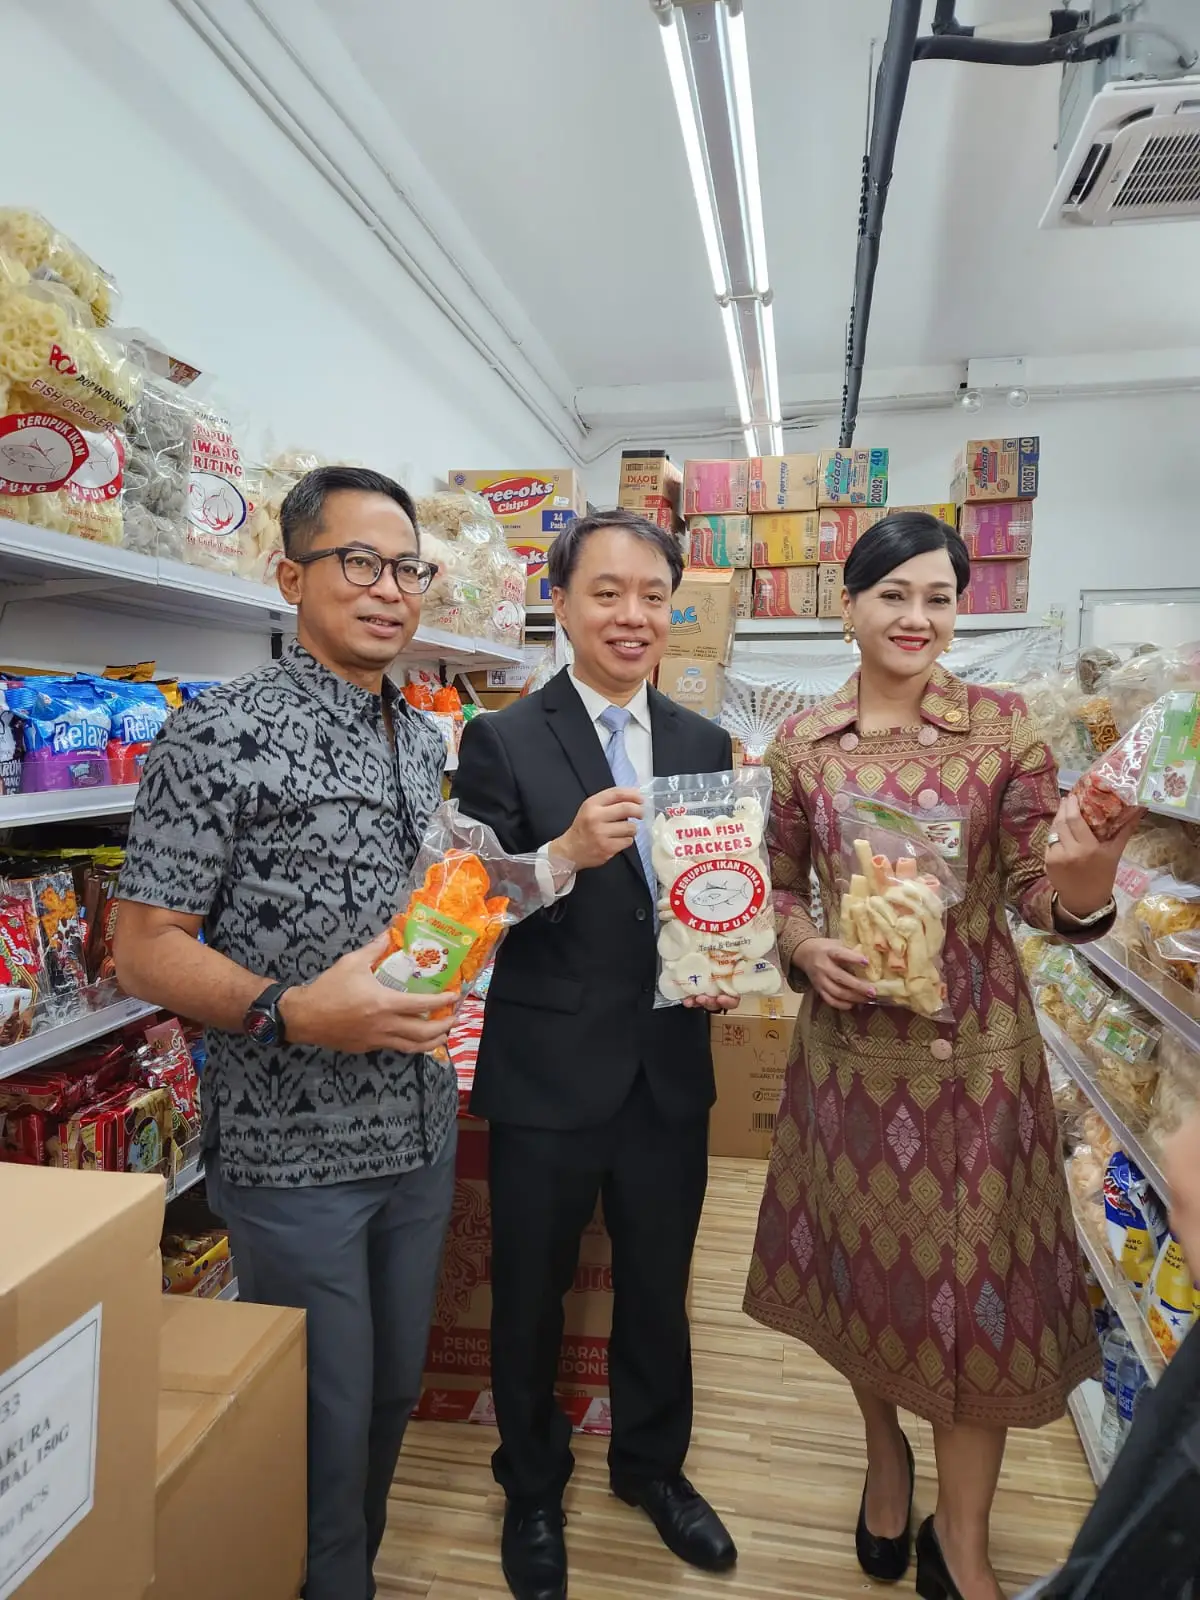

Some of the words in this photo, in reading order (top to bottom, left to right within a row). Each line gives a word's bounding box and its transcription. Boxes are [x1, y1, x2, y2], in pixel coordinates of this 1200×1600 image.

[31, 379, 62, 402] FISH
[62, 398, 117, 433] CRACKERS
[17, 415, 71, 434] KERUPUK
[68, 431, 86, 457] IKAN
[1021, 438, 1034, 454] 40
[871, 450, 883, 466] 40
[831, 452, 843, 501] Sedaap
[870, 479, 883, 503] 20092
[497, 499, 529, 513] Chips
[53, 718, 109, 752] Relaxa
[675, 827, 711, 840] TUNA
[715, 823, 745, 836] FISH
[674, 837, 752, 857] CRACKERS
[675, 864, 715, 896] KERUPUK
[717, 861, 741, 870] IKAN
[743, 864, 761, 887] TUNA
[688, 905, 758, 932] KAMPUNG
